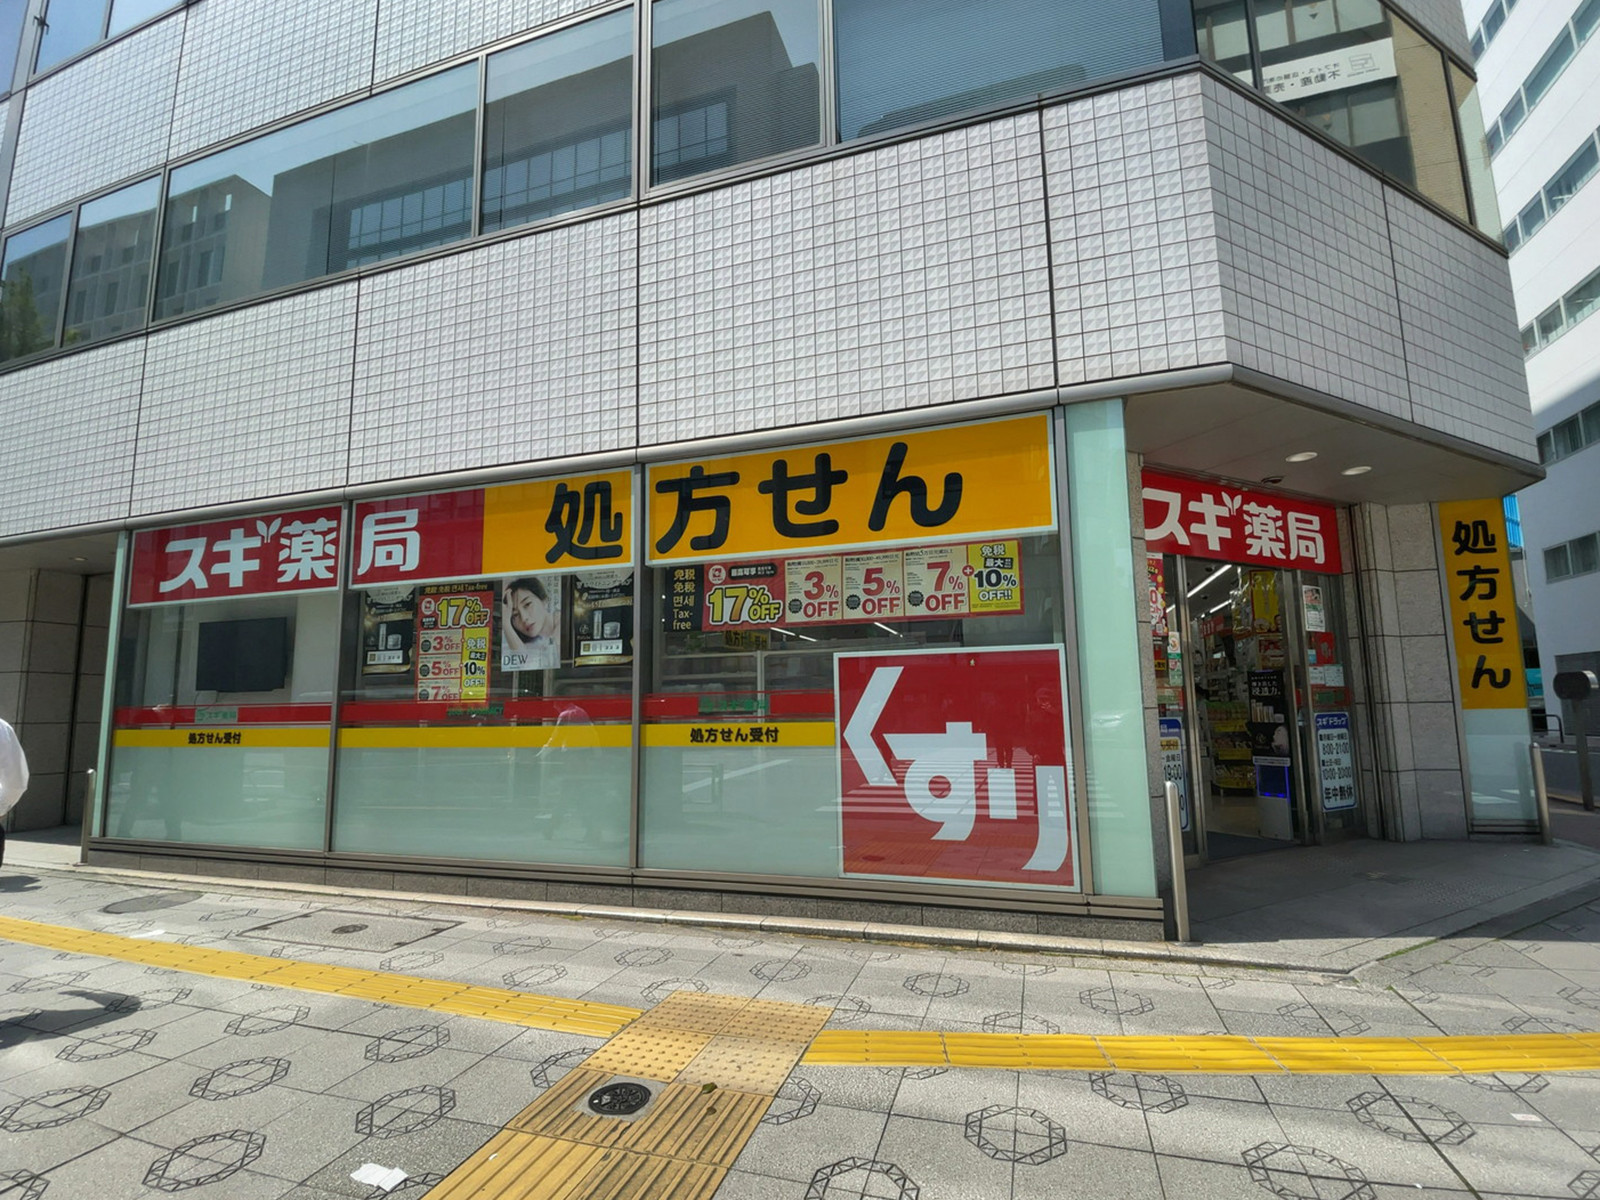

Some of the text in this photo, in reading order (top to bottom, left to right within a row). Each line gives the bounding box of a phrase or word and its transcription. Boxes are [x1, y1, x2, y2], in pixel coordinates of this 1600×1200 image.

[544, 442, 963, 566] 処方せん
[1142, 488, 1325, 564] スギ薬局
[159, 508, 421, 593] スギ薬局
[862, 567, 900, 596] 5%
[926, 561, 963, 592] 7%
[974, 568, 1017, 588] 10%
[803, 571, 839, 600] 3%
[673, 595, 695, 607] 면세
[708, 586, 770, 623] 17%
[803, 601, 839, 618] OFF
[862, 597, 900, 615] OFF
[925, 593, 965, 612] OFF
[1452, 519, 1511, 689] 処方せん
[436, 599, 481, 627] 17%
[466, 611, 488, 626] OFF
[672, 609, 693, 618] Tax-
[749, 603, 781, 620] OFF
[672, 620, 692, 630] free
[433, 635, 454, 651] 3%
[443, 641, 461, 651] OFF
[431, 660, 452, 676] 5%
[503, 654, 528, 666] DEW
[443, 666, 460, 676] OFF
[464, 662, 486, 676] 10%
[188, 732, 242, 744] 処方せん受付
[690, 727, 779, 743] 処方せん受付
[842, 665, 1069, 872] くすり
